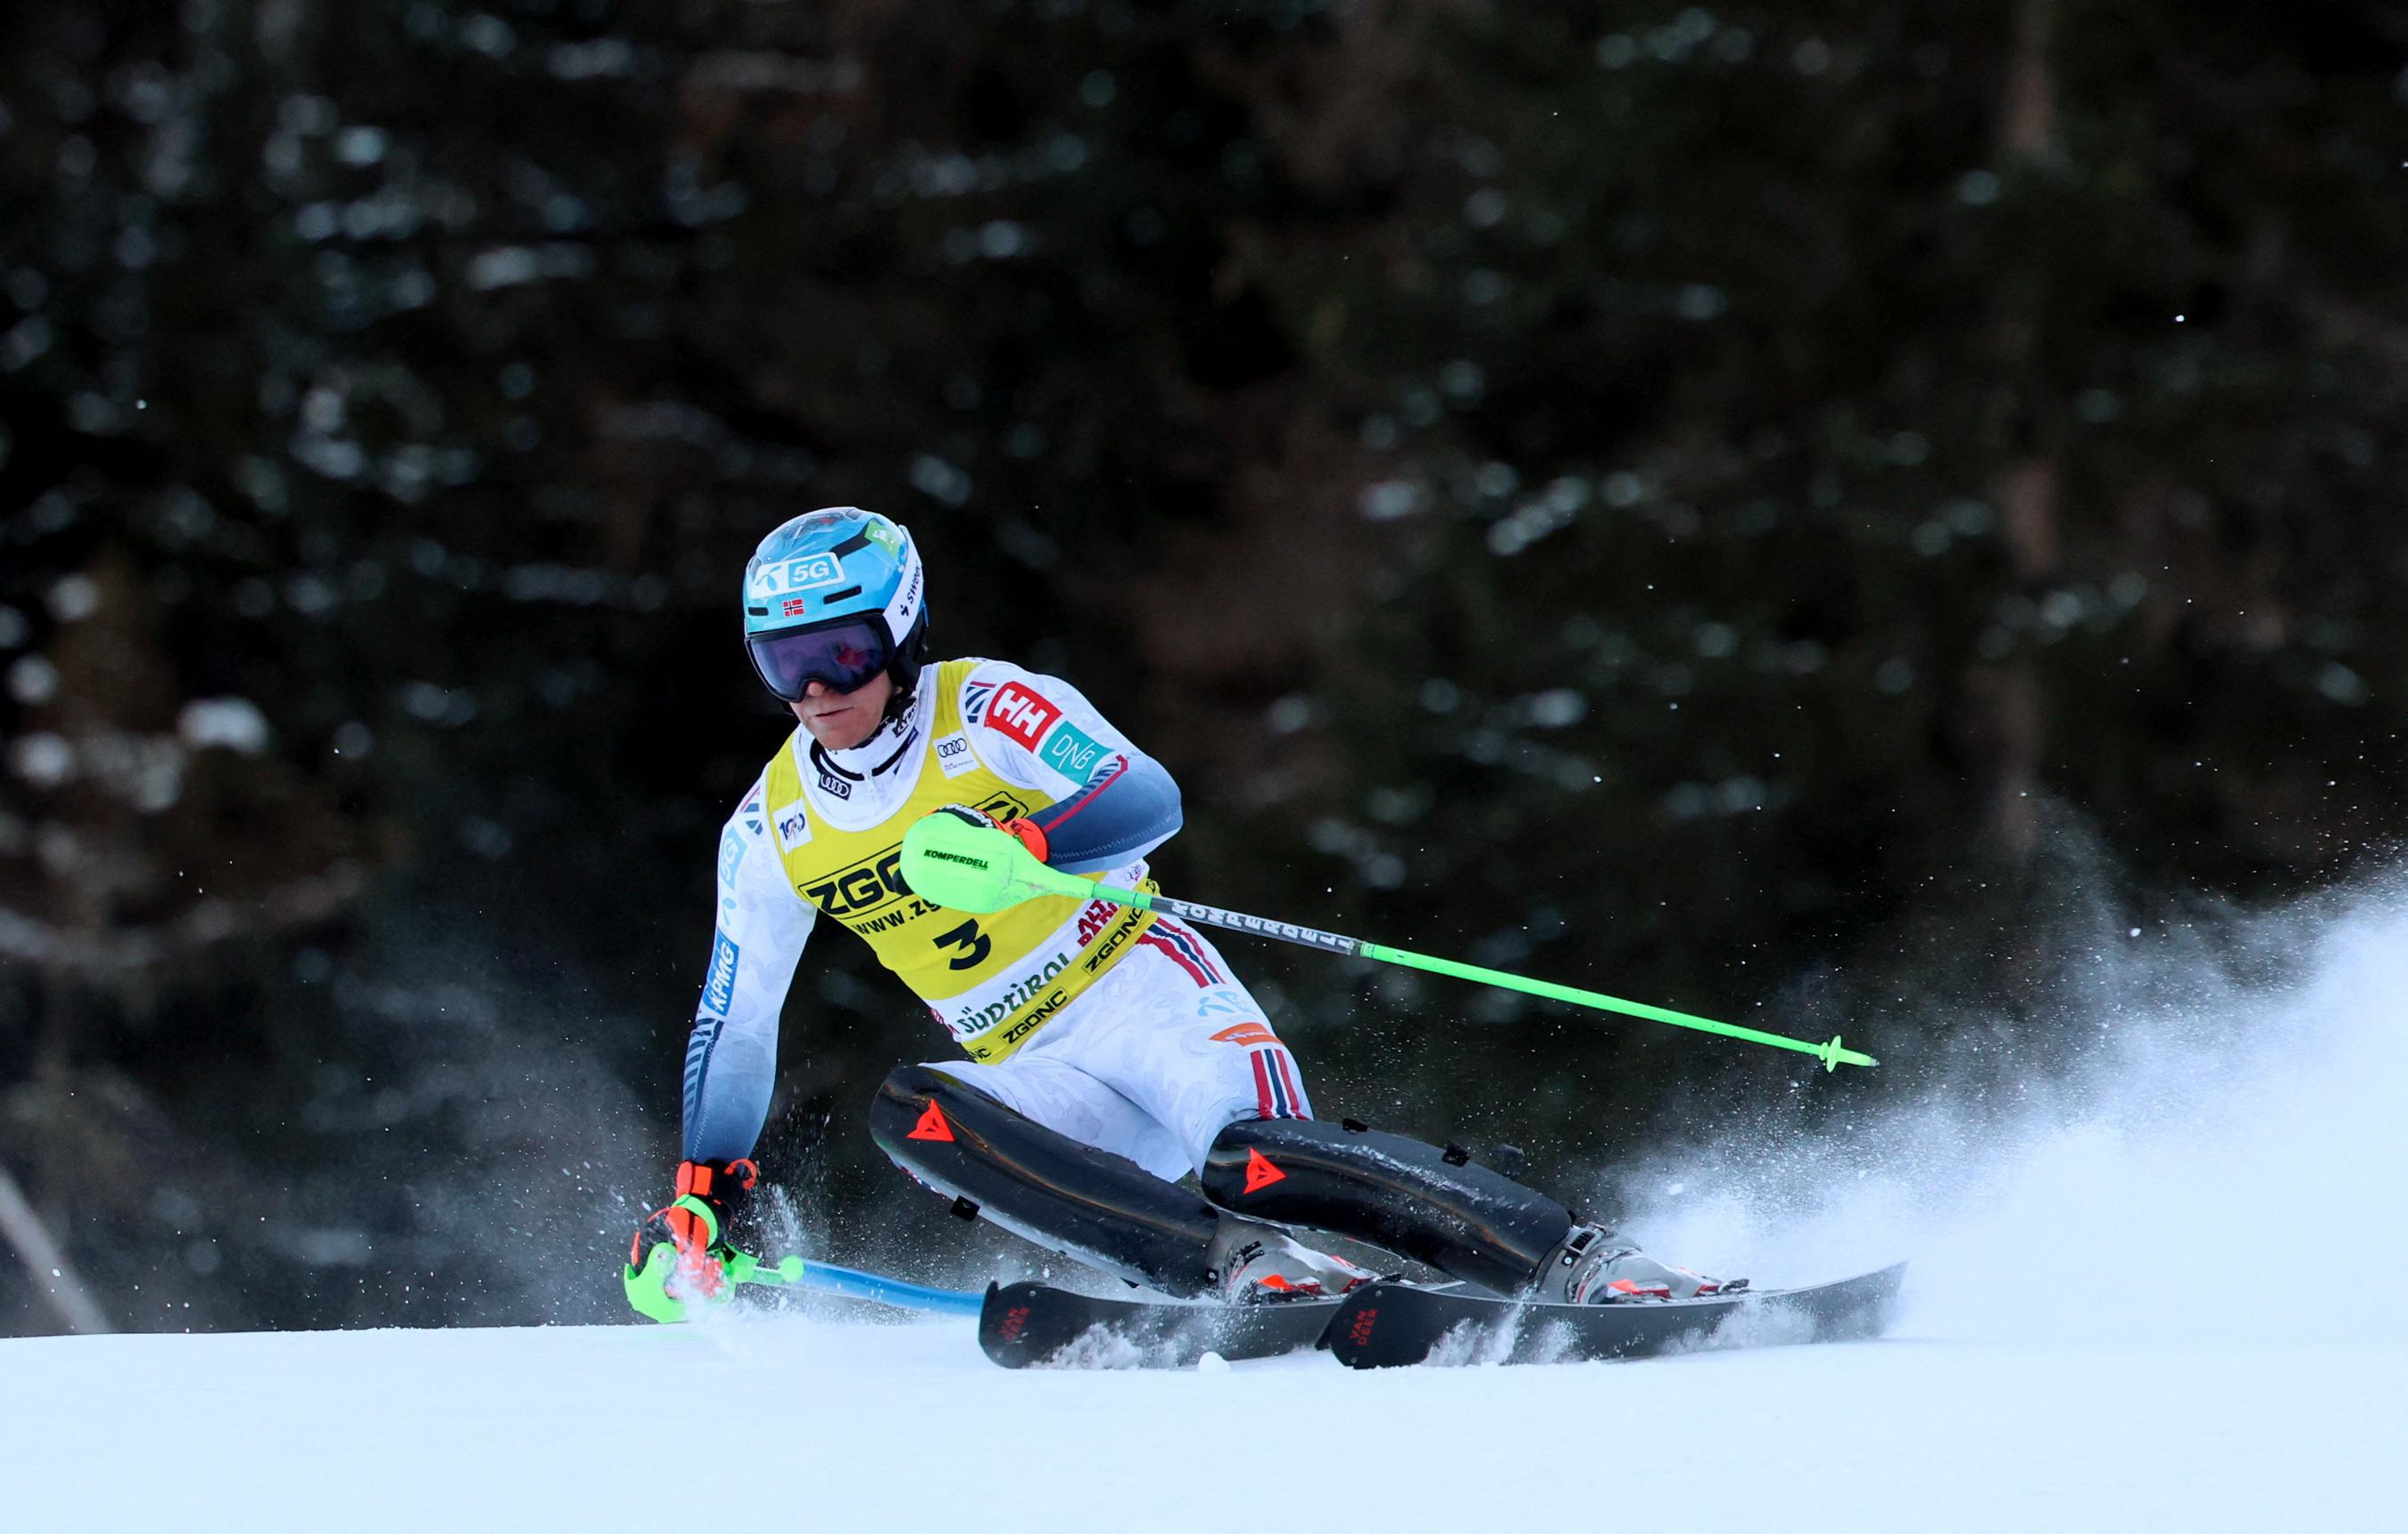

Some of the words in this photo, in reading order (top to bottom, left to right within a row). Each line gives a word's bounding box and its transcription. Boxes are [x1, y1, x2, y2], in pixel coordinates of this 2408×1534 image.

[793, 561, 829, 583] 5G
[993, 688, 1048, 738] HH
[1052, 734, 1095, 770] DNB
[924, 849, 988, 868] KOMPERDELL
[932, 917, 992, 971] 3
[1084, 907, 1145, 972] ZGONC
[1172, 901, 1353, 949] KOMPERDELL
[711, 940, 737, 1011] KPMG
[1002, 990, 1068, 1044] ZGONC
